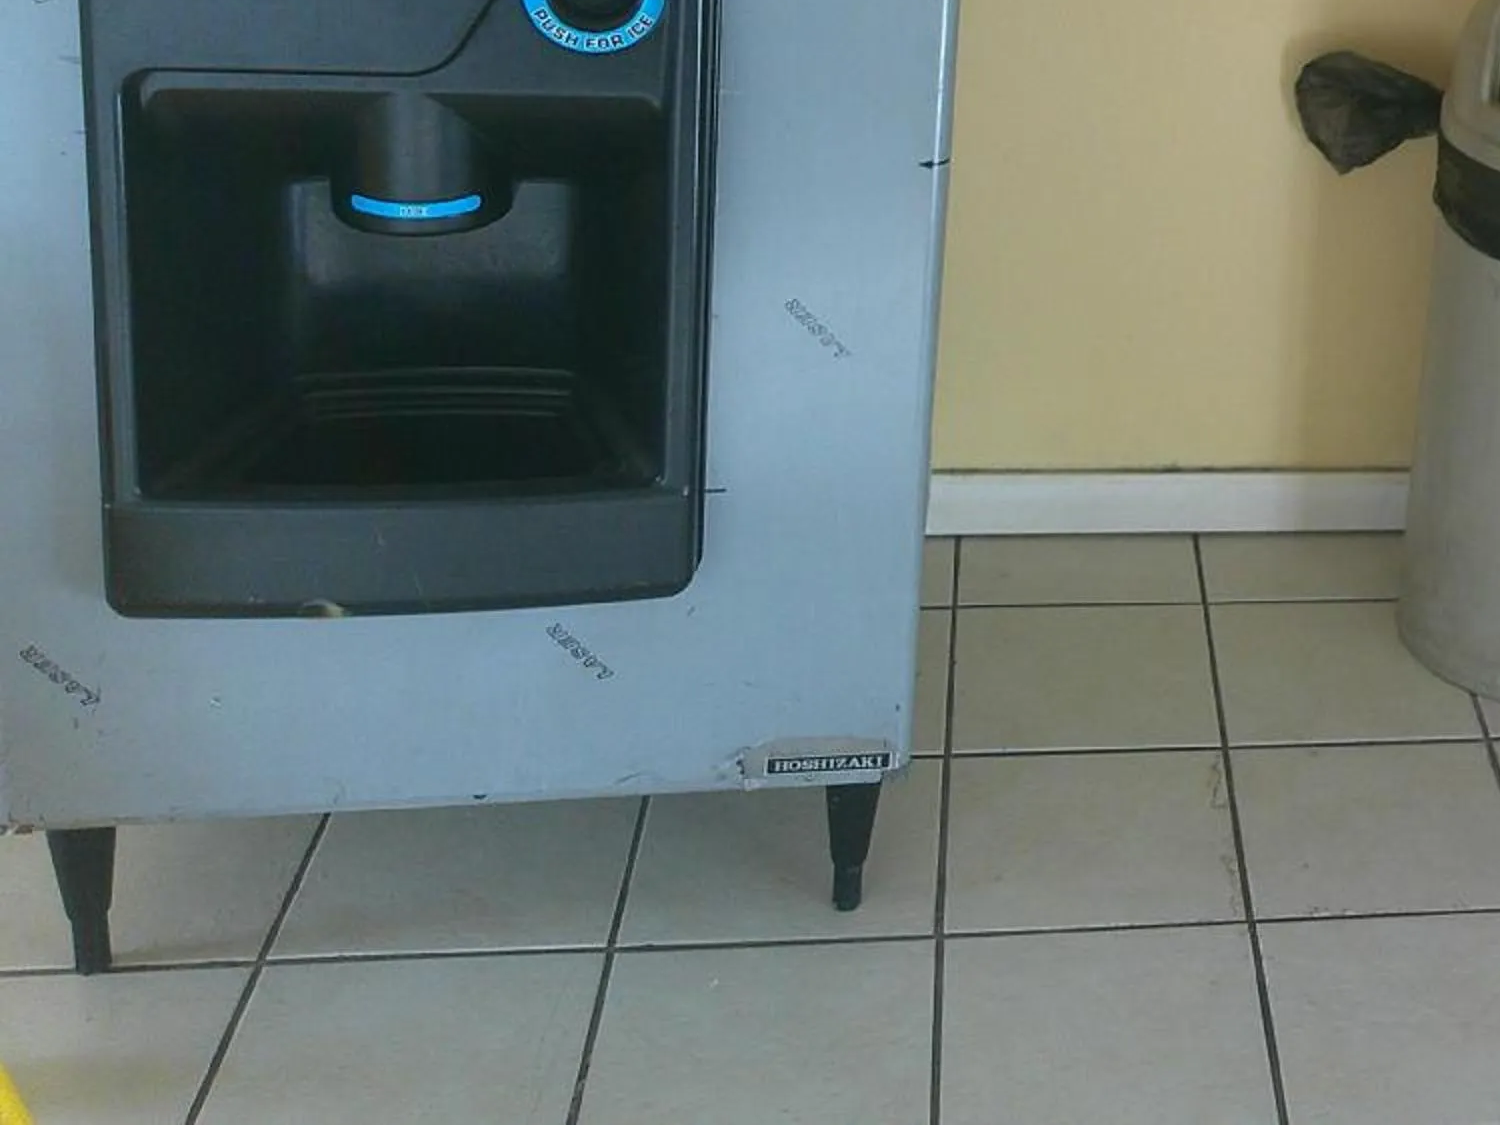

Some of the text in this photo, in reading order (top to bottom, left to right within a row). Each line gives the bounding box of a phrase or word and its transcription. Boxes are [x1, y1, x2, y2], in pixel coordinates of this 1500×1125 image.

[534, 8, 653, 49] PUSH FOR ICE
[775, 756, 882, 772] HOSHIZAKI
